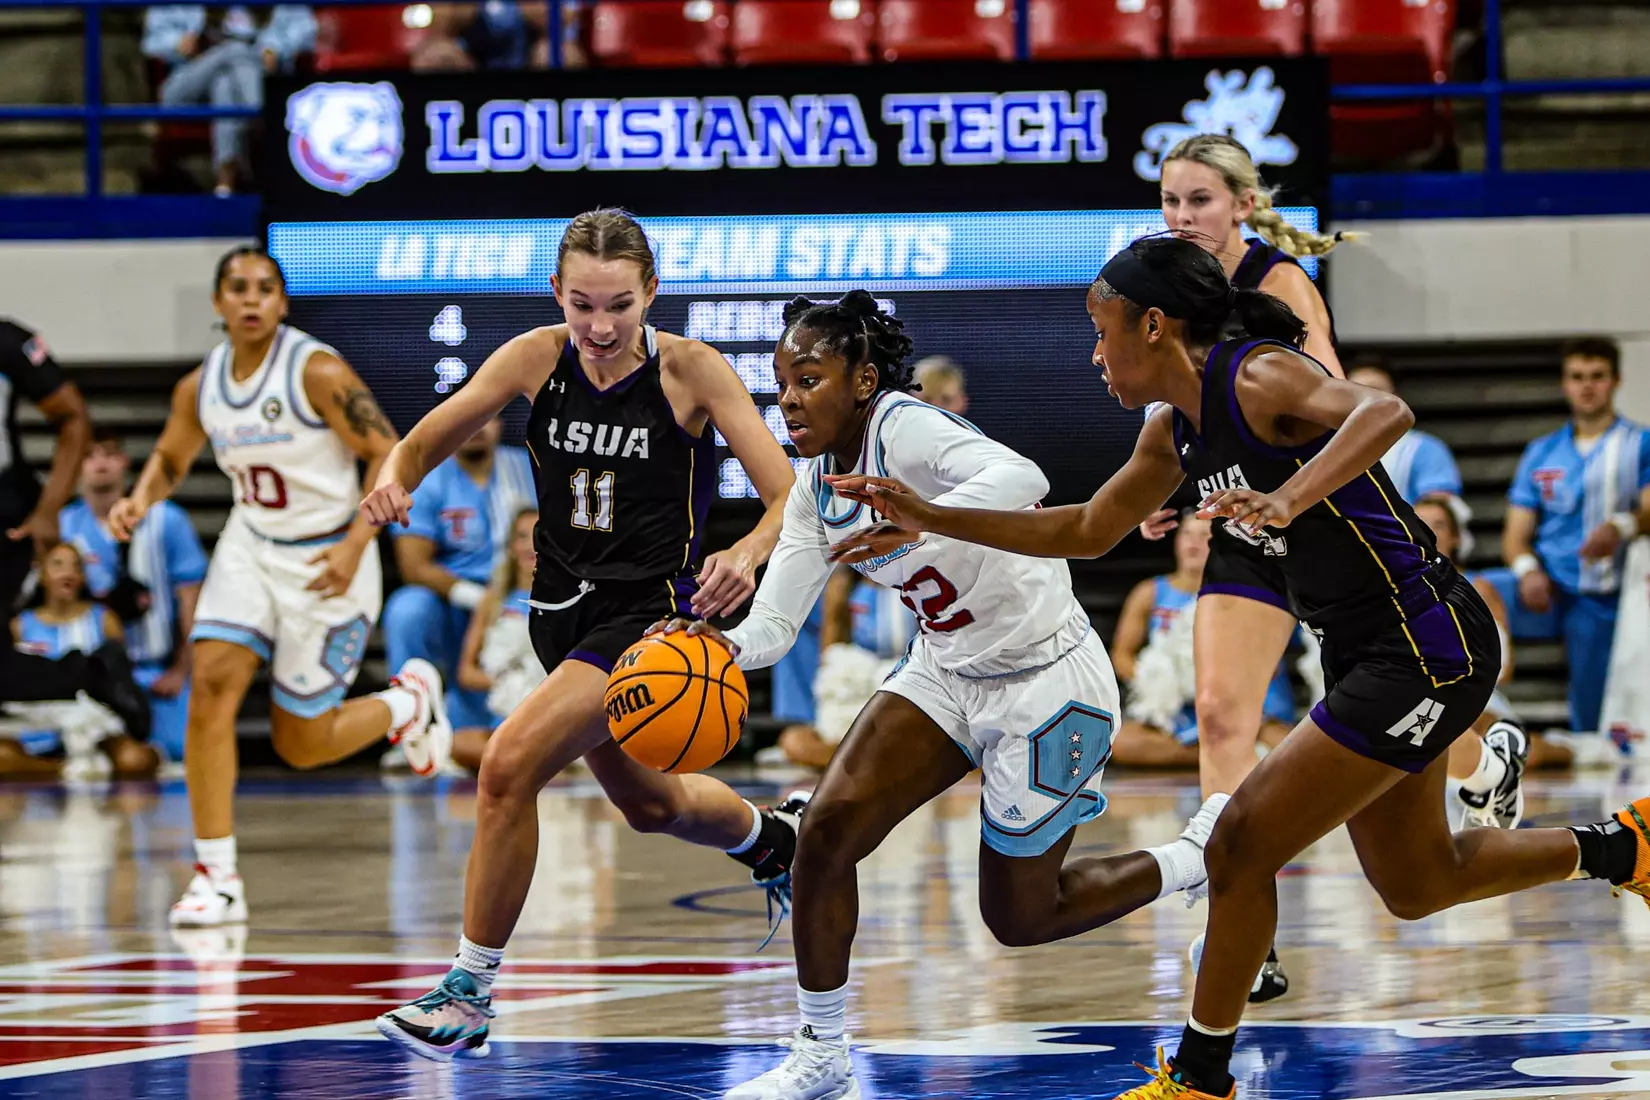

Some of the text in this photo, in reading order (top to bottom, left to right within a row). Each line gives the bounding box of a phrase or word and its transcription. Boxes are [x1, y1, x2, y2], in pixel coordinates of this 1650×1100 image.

[426, 95, 877, 174] LOUISIANA
[883, 89, 1108, 167] TECH
[650, 222, 952, 281] EAM STATS
[429, 305, 467, 346] 4
[548, 417, 649, 459] LSUA
[570, 468, 615, 532] 11
[1197, 463, 1252, 500] SUA
[891, 565, 976, 635] 2
